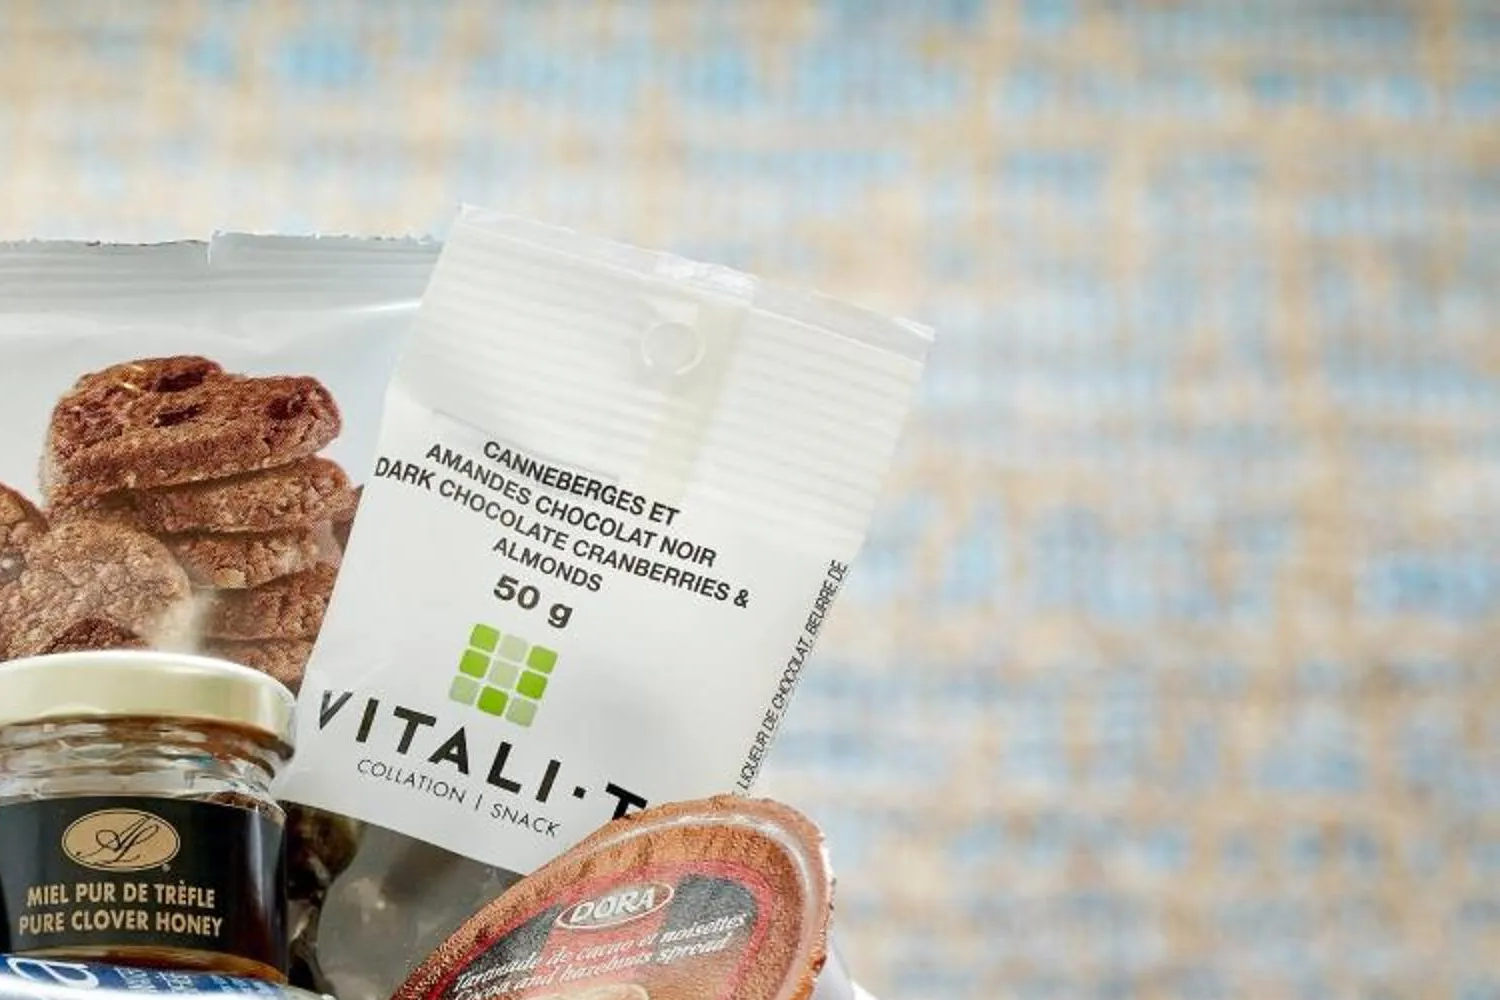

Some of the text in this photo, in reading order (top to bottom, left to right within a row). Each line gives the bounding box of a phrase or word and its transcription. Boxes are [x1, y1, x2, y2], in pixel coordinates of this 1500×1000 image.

[426, 443, 718, 568] AMANDES CHOCOLAT NOIR
[483, 440, 681, 527] CANNEBERGES ET
[374, 456, 750, 609] DARK CHOCOLATE CRANBERRIES &
[493, 537, 604, 592] ALMONDS
[493, 574, 574, 630] 50 g
[736, 730, 771, 790] LIQUEUR
[761, 708, 779, 732] DE
[827, 559, 849, 582] DE
[356, 758, 468, 805] COLLATION
[490, 802, 564, 838] SNACK
[26, 879, 216, 909] MIEL PUR DE TRÈFLE
[569, 886, 656, 924] DORA
[18, 908, 224, 937] PURE CLOVER HONEY
[659, 914, 749, 945] noisettes
